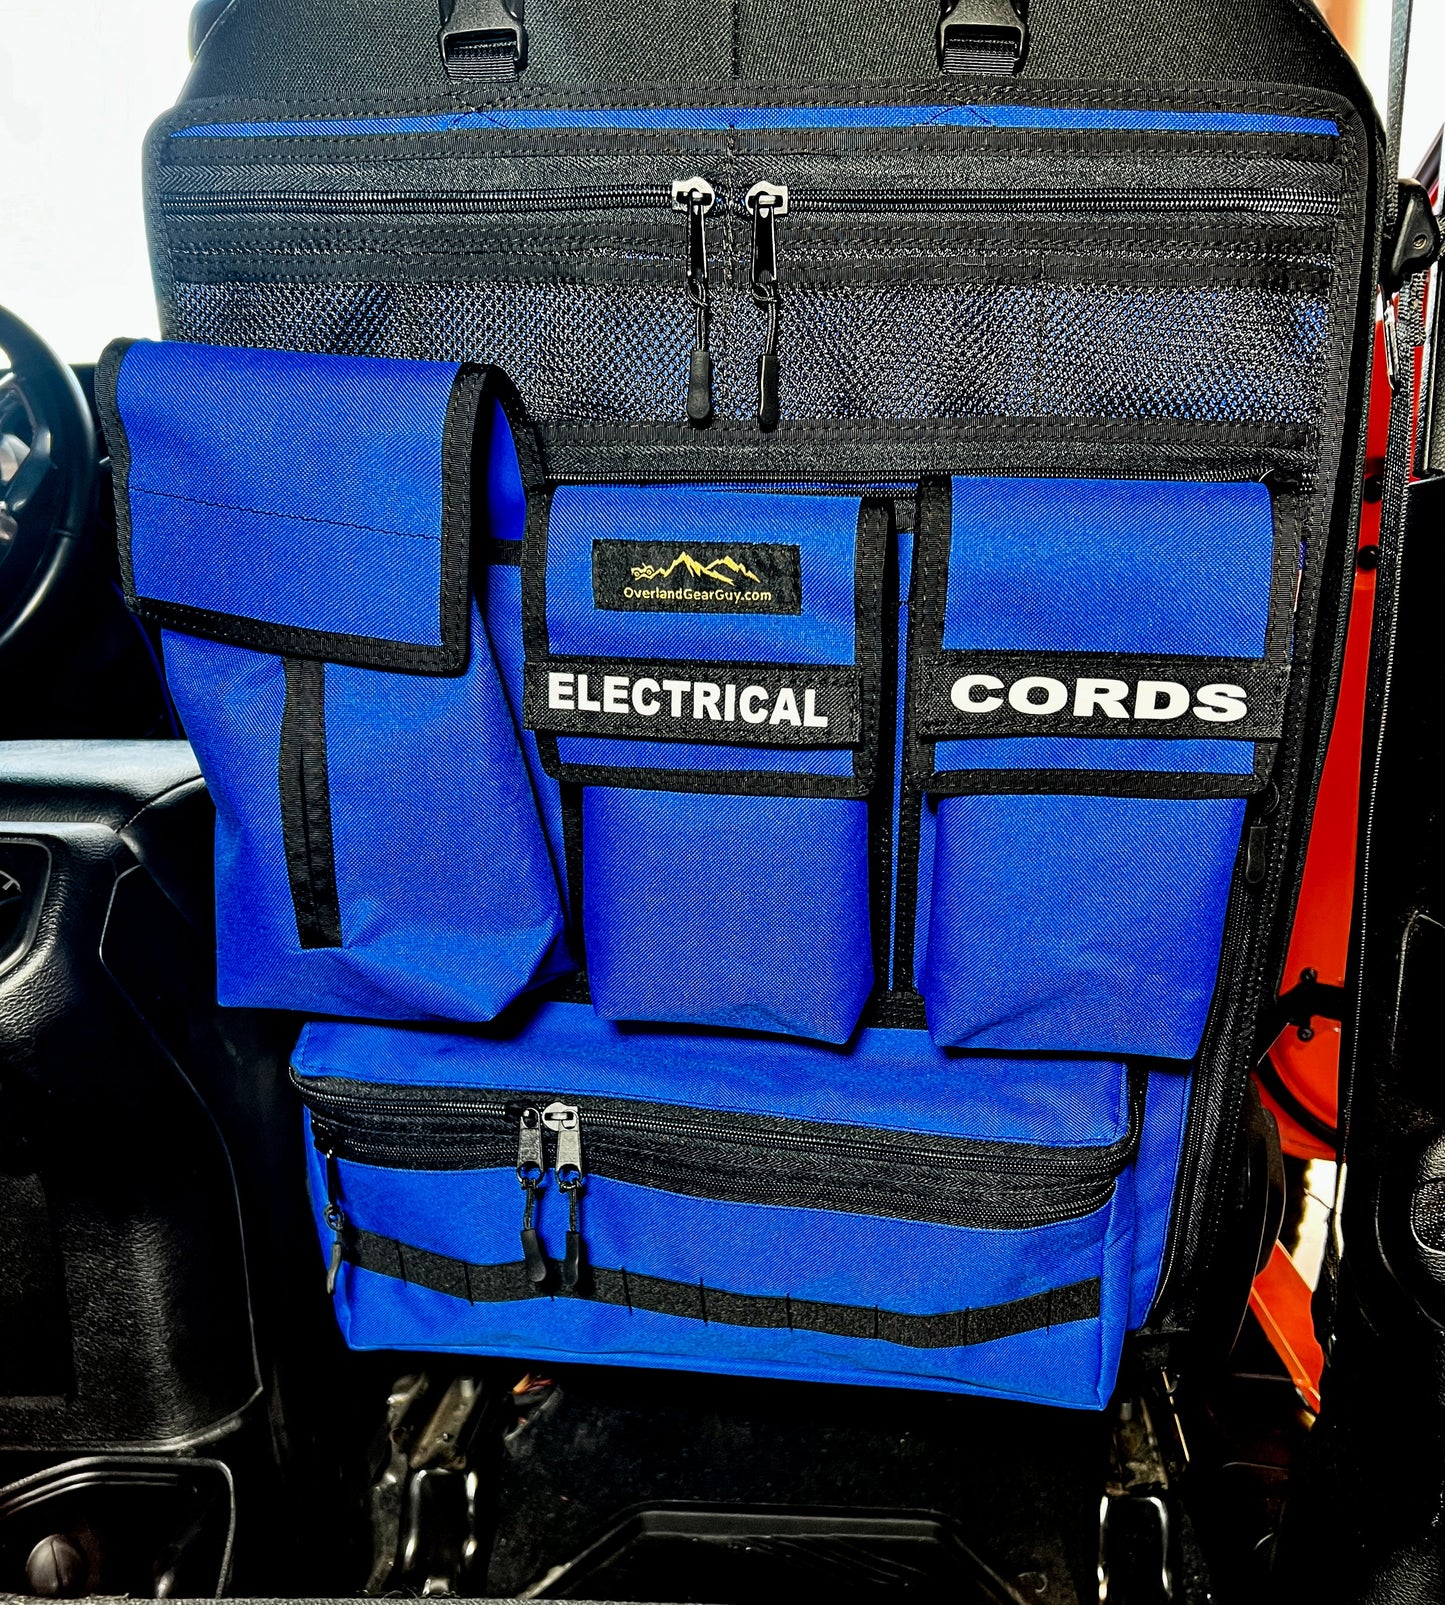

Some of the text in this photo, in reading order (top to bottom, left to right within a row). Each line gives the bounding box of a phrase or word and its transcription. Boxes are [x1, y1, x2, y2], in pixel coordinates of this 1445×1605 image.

[623, 586, 772, 604] OverlandGearGuy.com
[547, 671, 829, 728] ELECTRICAL
[950, 674, 1248, 723] CORDS
